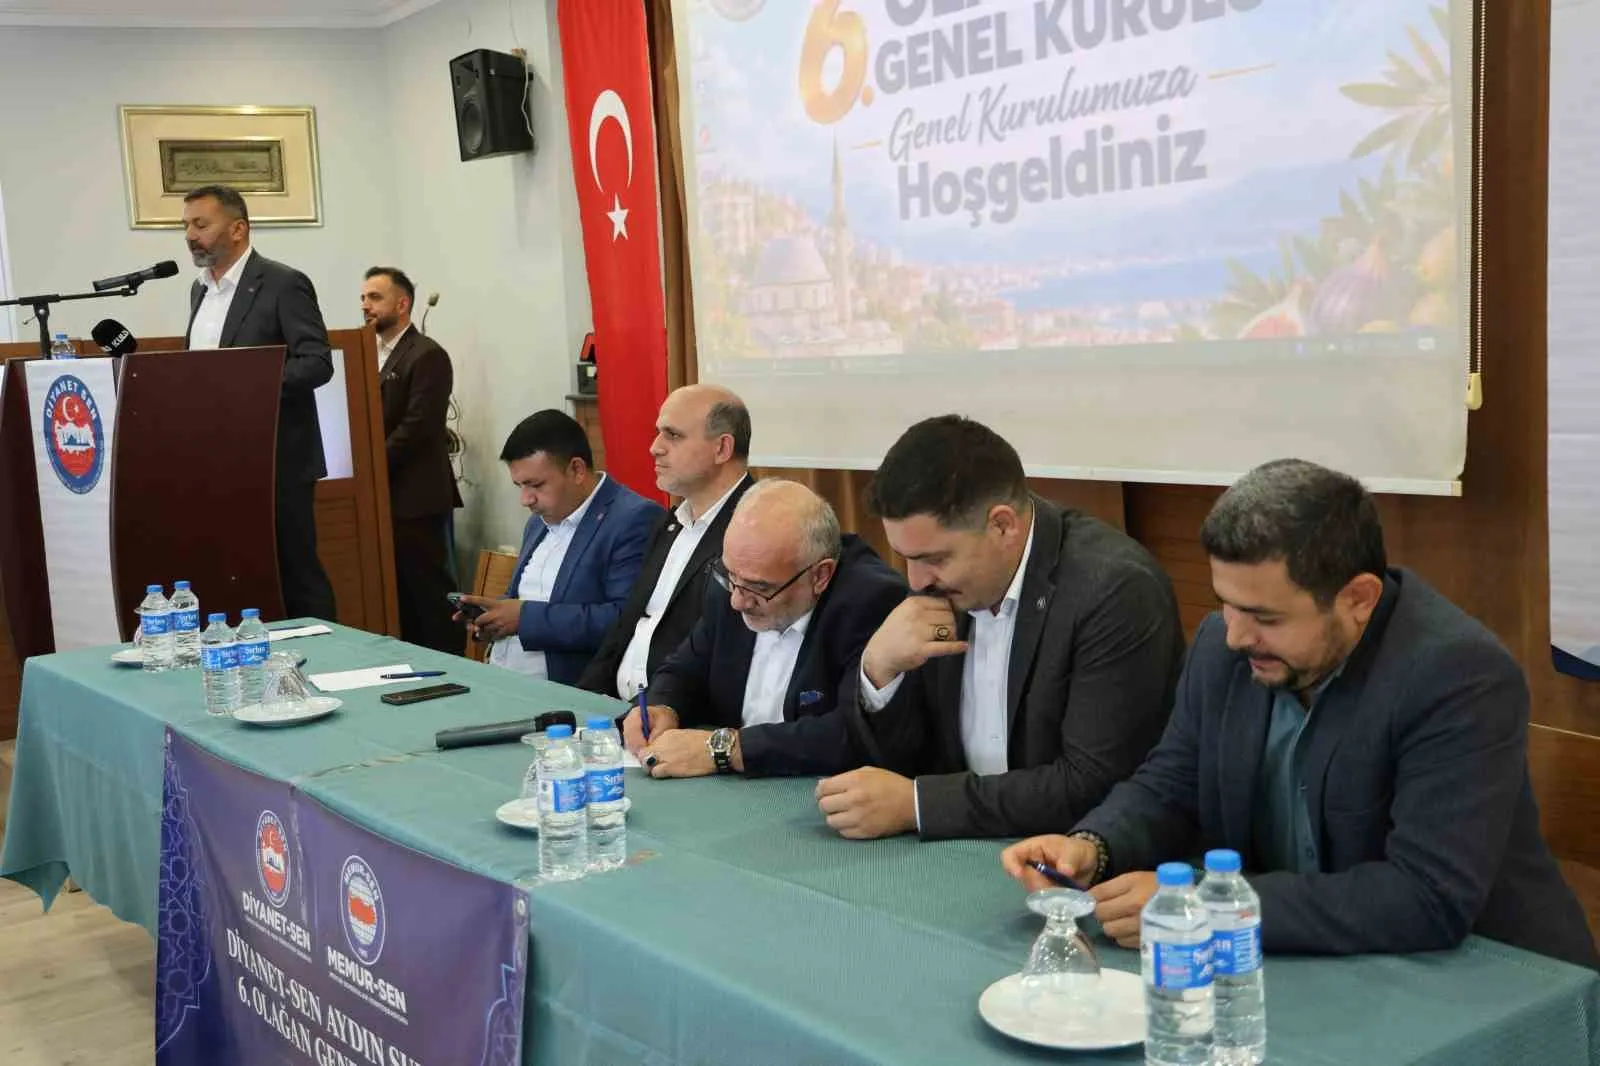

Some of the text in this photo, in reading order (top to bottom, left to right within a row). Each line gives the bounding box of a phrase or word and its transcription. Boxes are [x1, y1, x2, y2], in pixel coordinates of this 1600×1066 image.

[798, 0, 874, 124] 6.
[874, 0, 1264, 94] GENEL KURU
[888, 66, 1198, 163] Genel Kurulumuza
[897, 114, 1208, 229] Hoşgeldiniz
[241, 890, 312, 953] DİYANET-SEN
[226, 928, 323, 1026] DİYANET-SEN
[326, 1004, 385, 1066] AYDIN
[237, 976, 251, 1009] 6.
[252, 986, 313, 1058] OLAĞAN
[327, 945, 407, 1013] MEMUR-SEN
